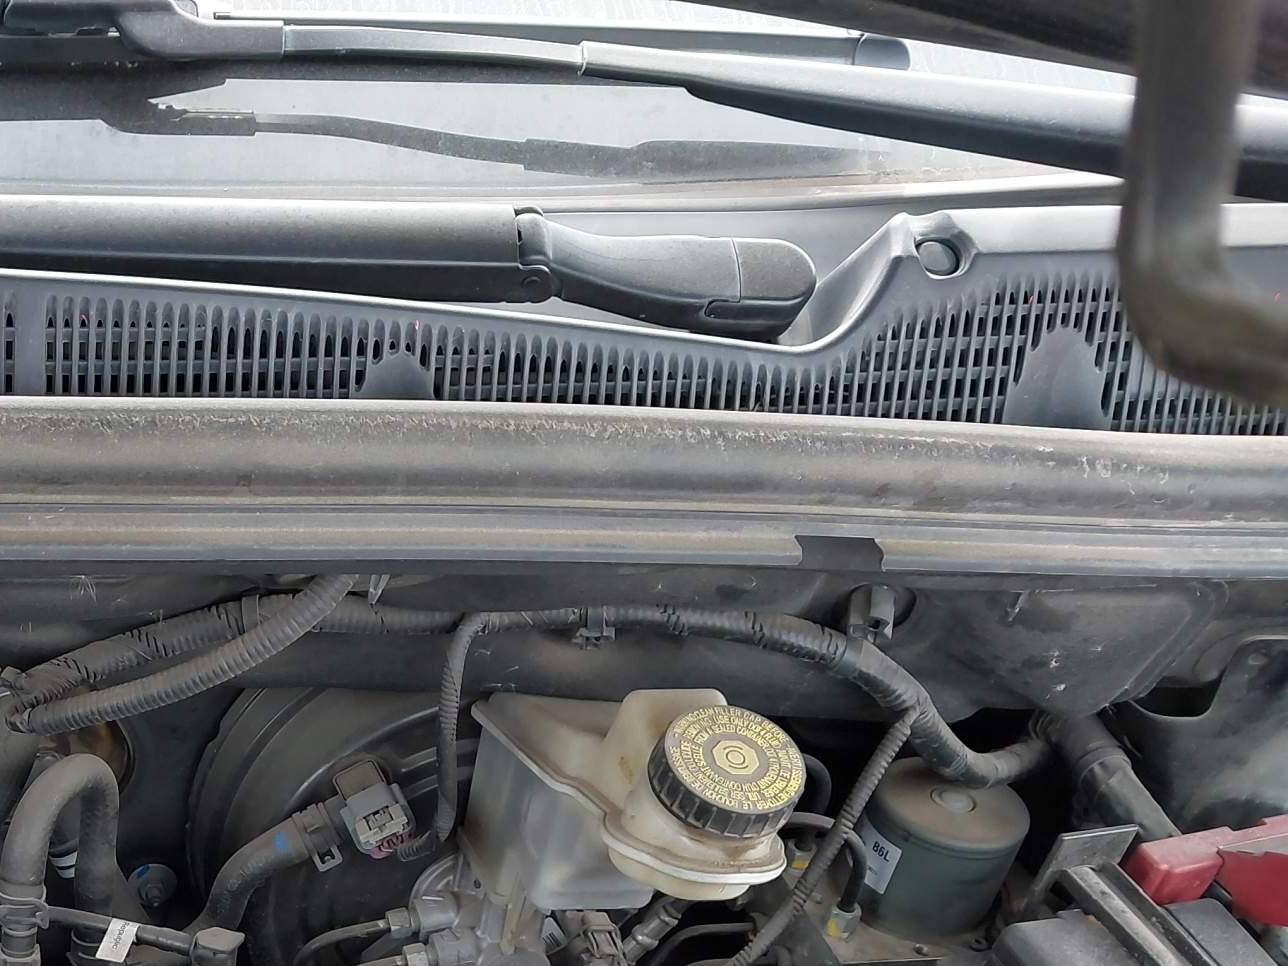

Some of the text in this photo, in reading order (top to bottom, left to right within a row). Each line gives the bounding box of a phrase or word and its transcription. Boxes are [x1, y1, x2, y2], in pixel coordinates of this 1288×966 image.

[713, 707, 740, 717] FILLER
[743, 711, 761, 724] CAP
[730, 716, 748, 727] ONLY
[710, 724, 735, 733] SEALED
[742, 801, 753, 810] LE
